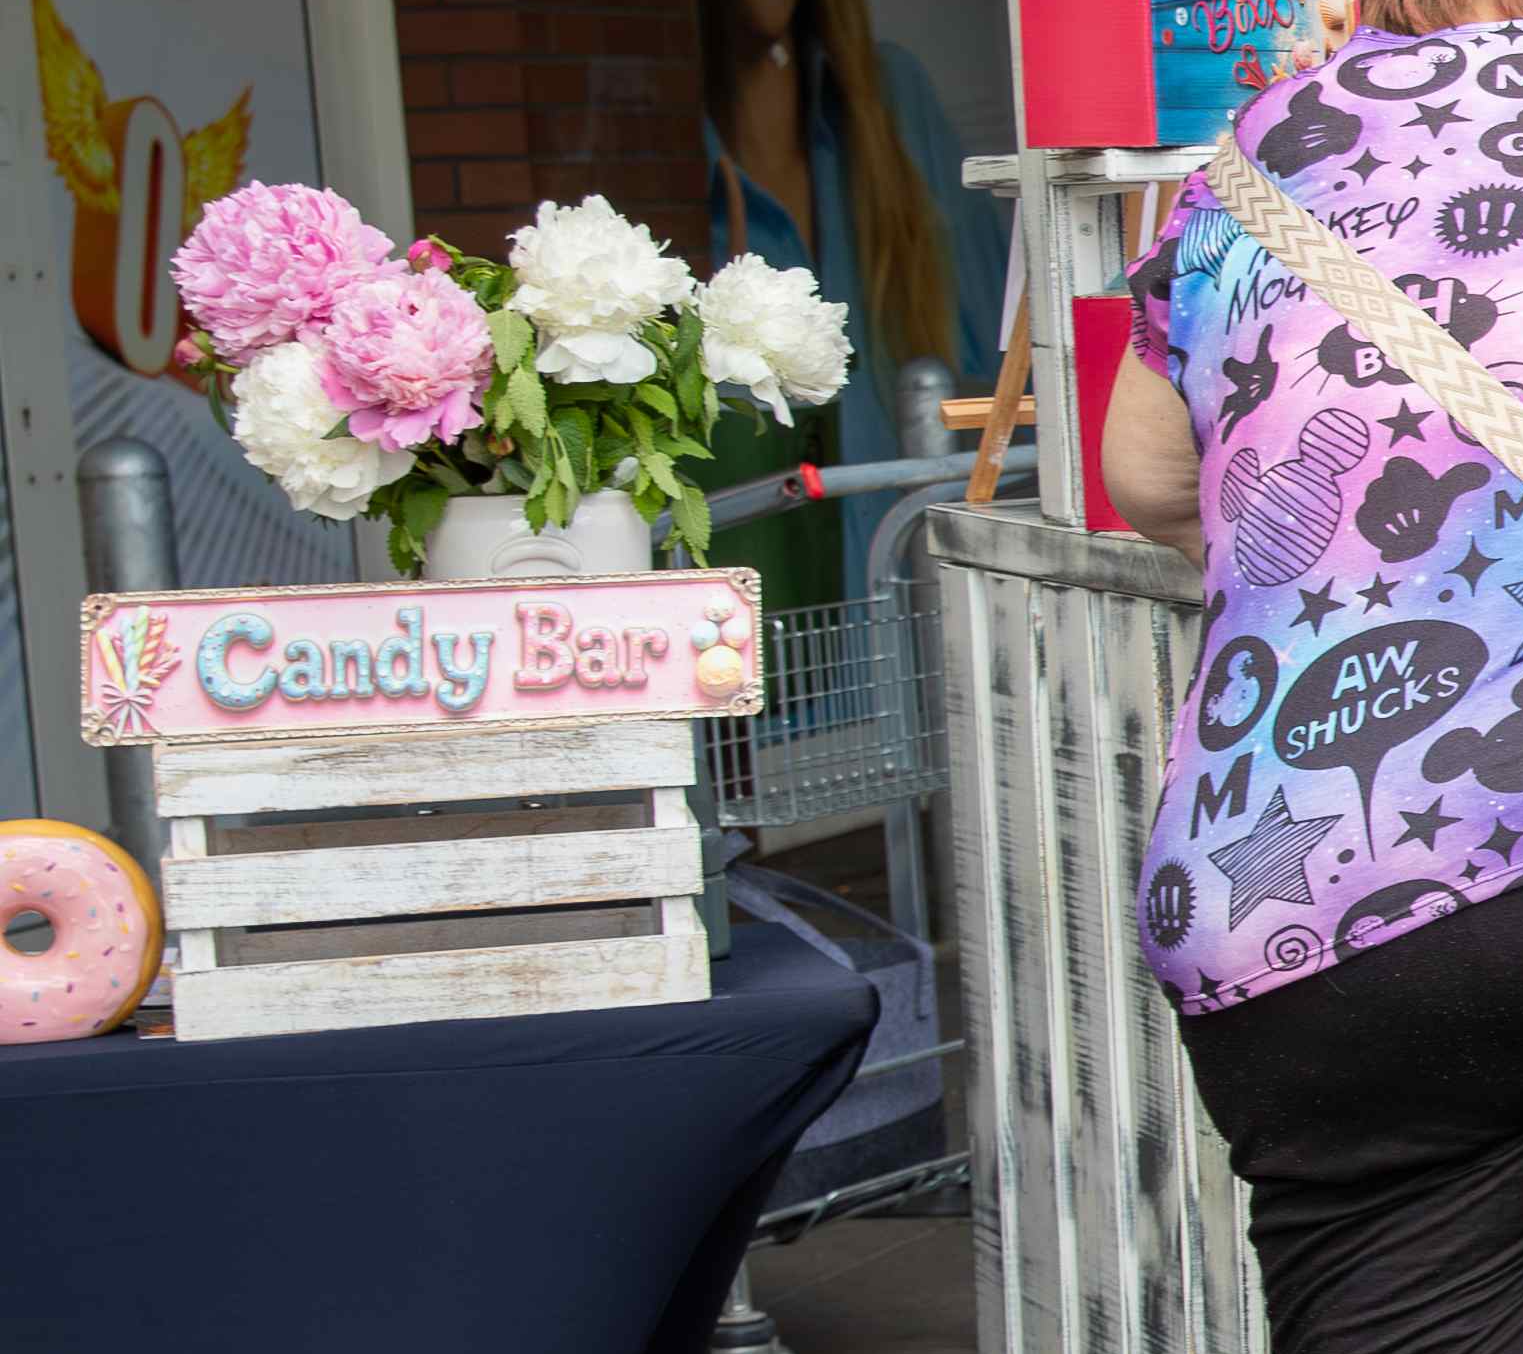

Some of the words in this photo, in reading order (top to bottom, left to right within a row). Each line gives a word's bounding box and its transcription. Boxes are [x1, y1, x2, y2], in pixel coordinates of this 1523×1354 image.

[197, 606, 495, 713] Candy
[512, 600, 669, 692] Bar
[1286, 666, 1462, 760] SHUCKS
